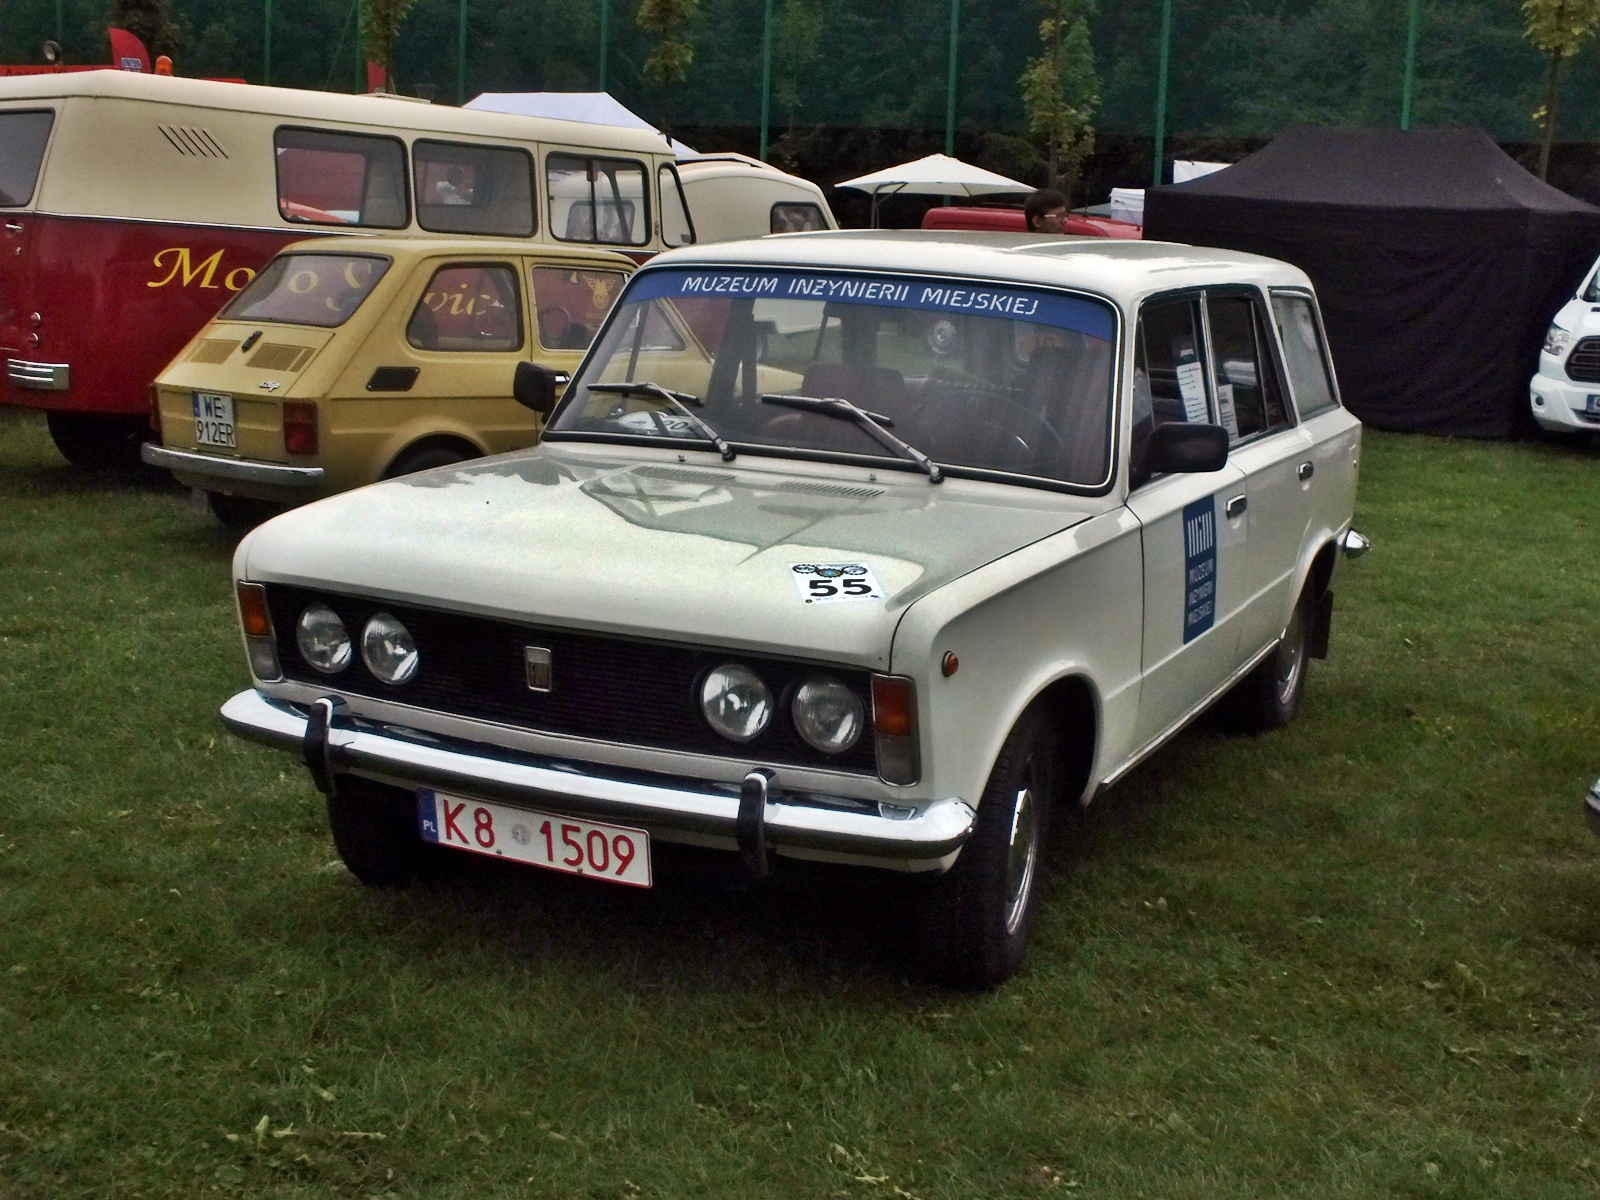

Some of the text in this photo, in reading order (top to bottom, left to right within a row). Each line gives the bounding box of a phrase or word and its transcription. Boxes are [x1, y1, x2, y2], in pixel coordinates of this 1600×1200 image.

[681, 276, 779, 293] MUZEUM
[920, 287, 1039, 315] MIEJSKIEJ
[203, 396, 223, 418] WE
[197, 420, 235, 445] 912ER
[809, 578, 872, 597] 55
[423, 819, 436, 833] PL
[443, 799, 635, 876] K8 1509
